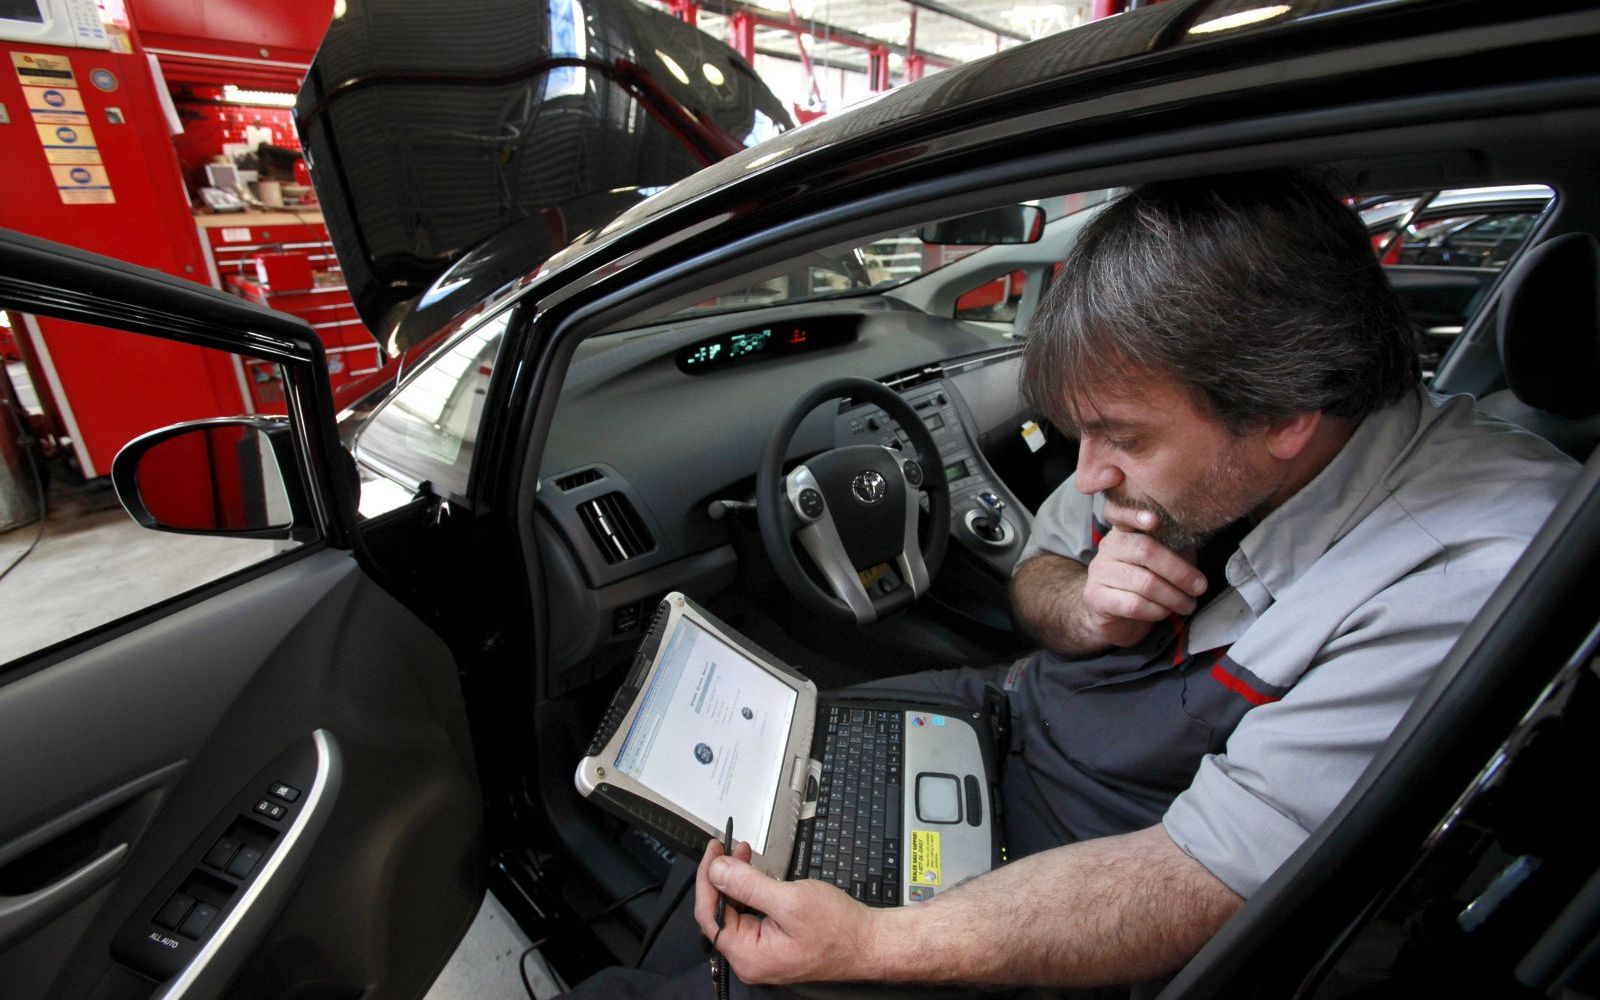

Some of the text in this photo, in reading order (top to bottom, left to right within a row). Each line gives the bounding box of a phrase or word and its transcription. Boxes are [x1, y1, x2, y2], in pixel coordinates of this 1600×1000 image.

[795, 841, 806, 875] Panasonic
[149, 932, 179, 948] ALL AUTO
